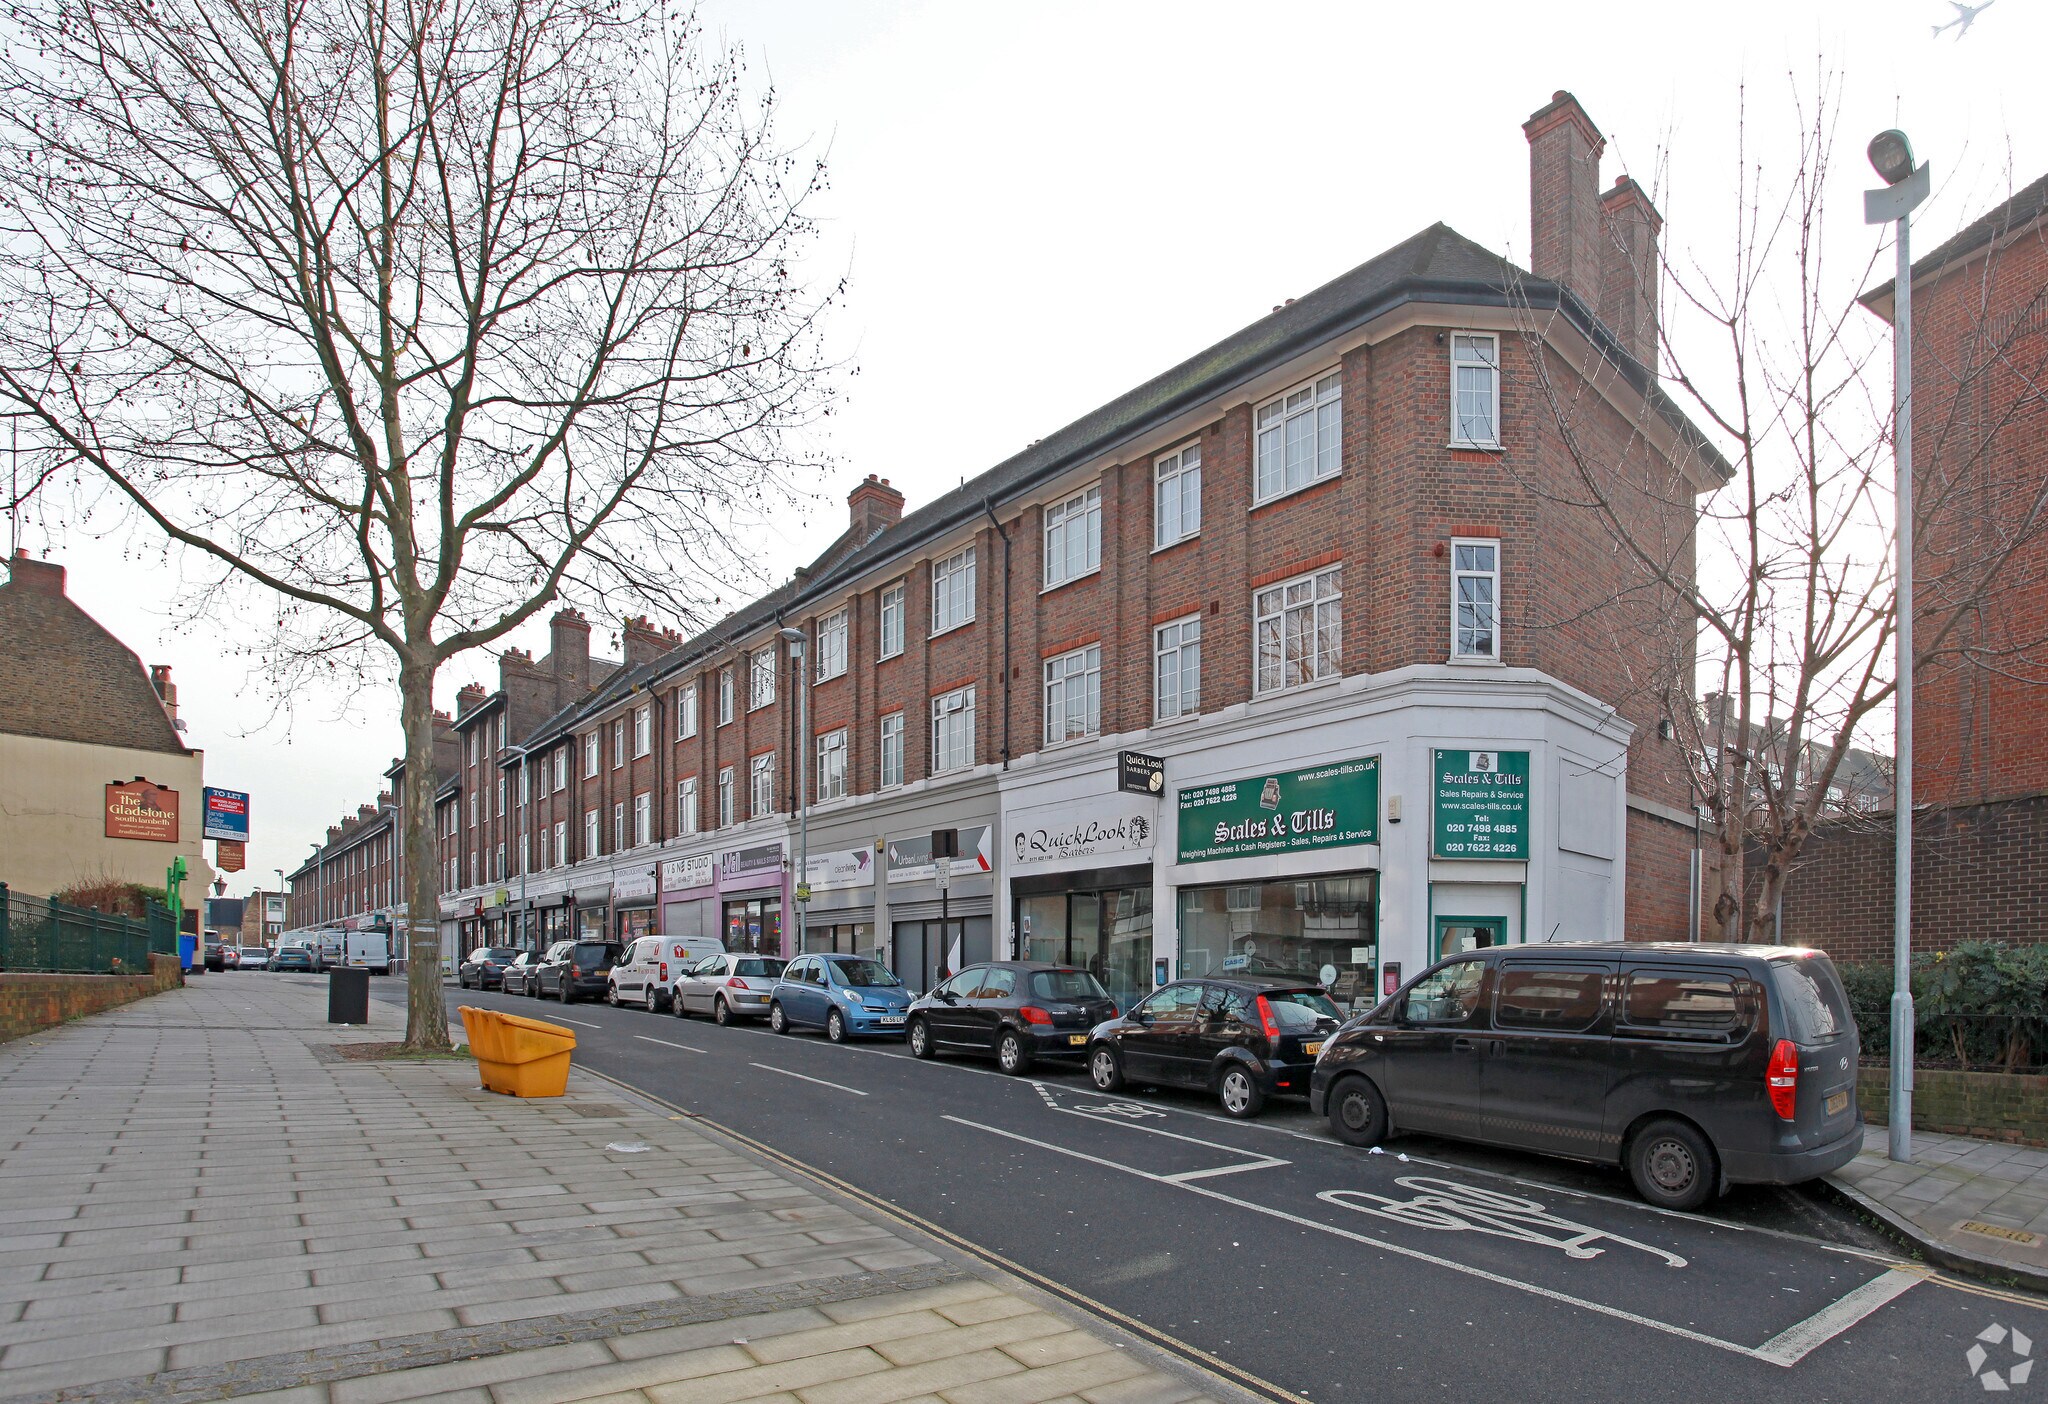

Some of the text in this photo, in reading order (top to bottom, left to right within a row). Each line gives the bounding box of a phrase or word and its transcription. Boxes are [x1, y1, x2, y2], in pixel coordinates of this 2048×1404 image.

[1126, 754, 1163, 769] Quick Look
[1126, 766, 1150, 775] BARBERS
[1297, 760, 1375, 782] www.scales-tills.co.uk
[1442, 771, 1522, 785] Scales & Tills
[213, 789, 242, 800] TO LET
[1181, 793, 1192, 801] Tel:
[1192, 790, 1204, 799] 020
[1440, 789, 1524, 800] Sales Repairs & Service
[120, 795, 141, 806] the
[1180, 802, 1193, 810] Fax:
[1193, 798, 1205, 807] 020
[109, 804, 175, 819] Gladstone
[1441, 802, 1522, 811] www.scales-tills.co.uk
[138, 816, 170, 826] lambeth
[1474, 814, 1489, 822] Tel:
[1214, 808, 1335, 844] Scales & Tills
[1446, 824, 1517, 833] 020 7498 4885
[1181, 849, 1206, 859] Weighing
[1207, 846, 1234, 856] Machines
[1235, 844, 1240, 852] &
[1240, 841, 1257, 851] Cash
[1257, 838, 1286, 850] Registers
[1291, 836, 1311, 846] Sales,
[1312, 833, 1338, 844] Repairs
[1338, 832, 1345, 840] &
[1345, 829, 1372, 839] Service
[1445, 843, 1517, 852] 020 7622 4226
[1058, 846, 1095, 859] Barbers
[687, 857, 708, 871] STUDIO
[1224, 958, 1244, 966] CASIO
